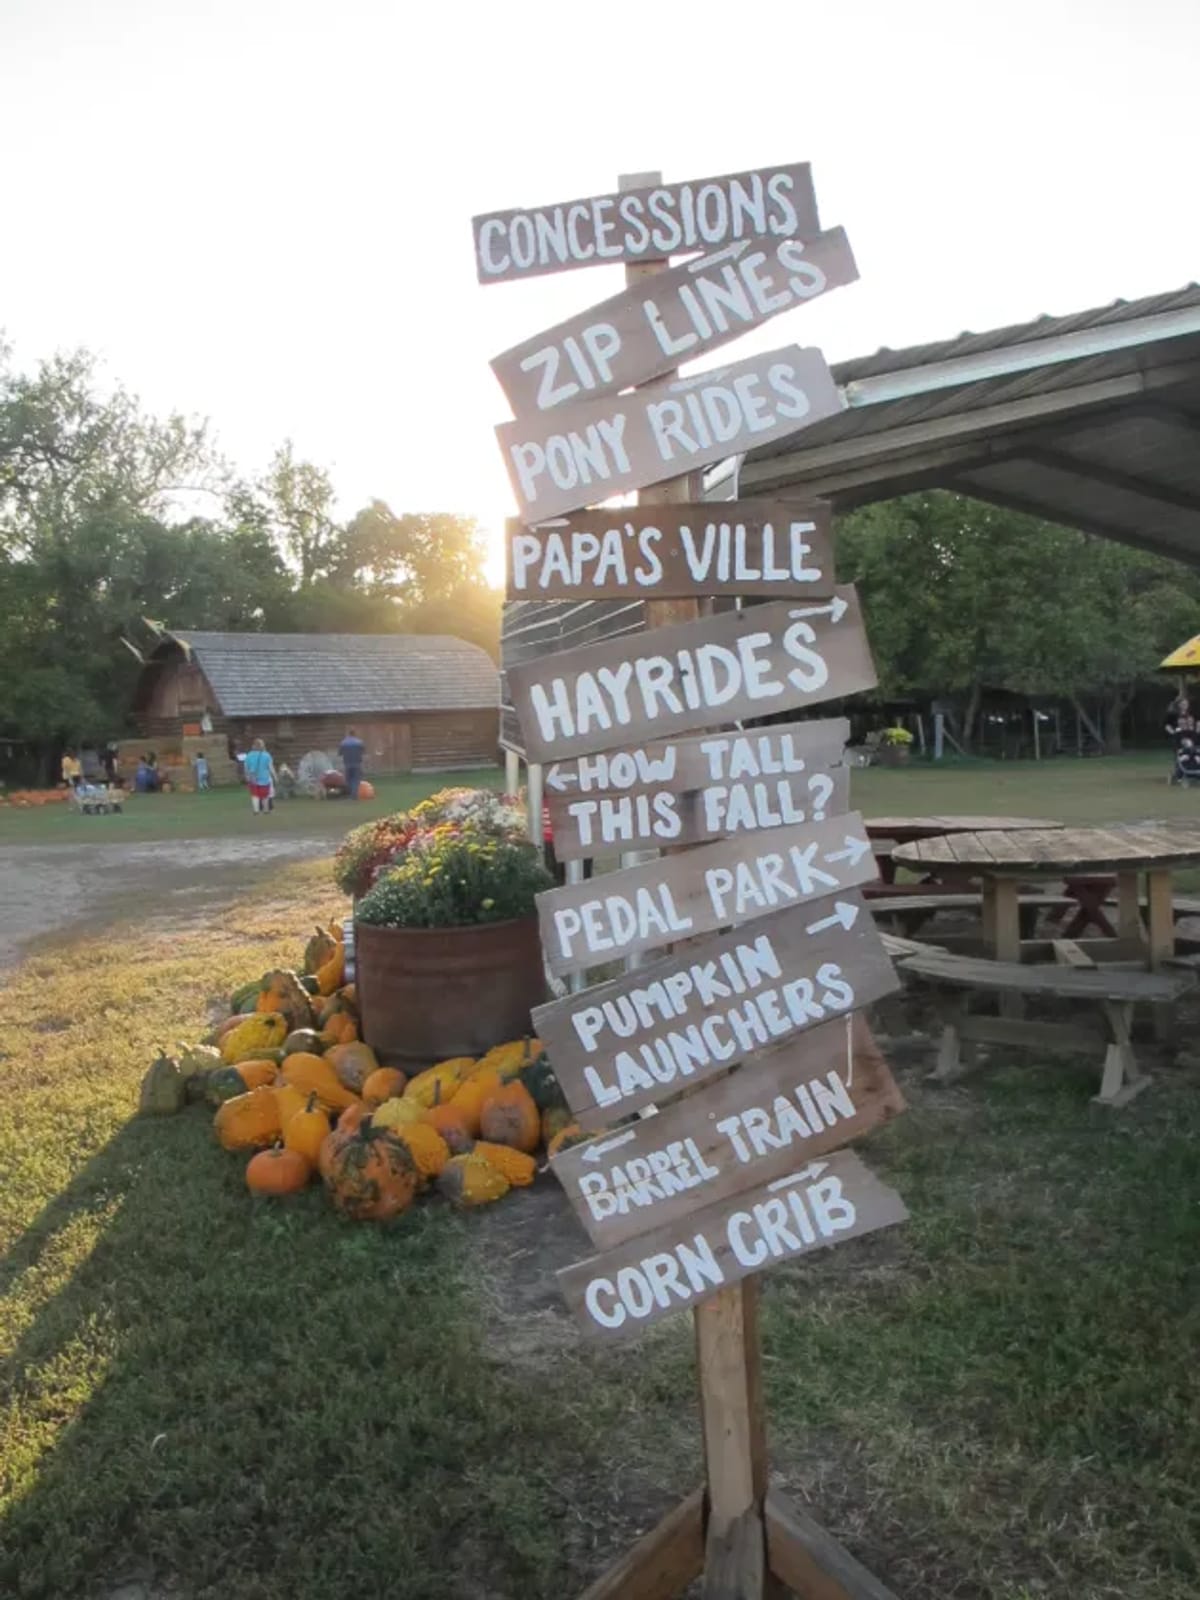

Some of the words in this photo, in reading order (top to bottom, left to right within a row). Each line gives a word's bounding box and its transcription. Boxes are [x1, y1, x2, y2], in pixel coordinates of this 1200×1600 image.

[478, 173, 798, 275] CONCESSIONS
[520, 322, 622, 410] ZIP
[642, 241, 827, 357] LINES
[510, 414, 632, 500] PONY
[646, 363, 811, 461] RIDES
[511, 522, 663, 589] PAPA'S
[680, 521, 822, 582] VILLE
[530, 621, 829, 743] HAYRIDES
[568, 791, 682, 846] THIS
[578, 745, 677, 791] HOW
[700, 733, 805, 780] TALL
[554, 882, 693, 958] PEDAL
[705, 841, 840, 919] PARK
[571, 935, 782, 1053] PUMPKIN
[583, 963, 854, 1107] LAUNCHERS
[578, 1137, 719, 1222] BARREL
[716, 1070, 856, 1164] TRAIN
[585, 1234, 725, 1329] CORN
[727, 1175, 856, 1267] CRIB
